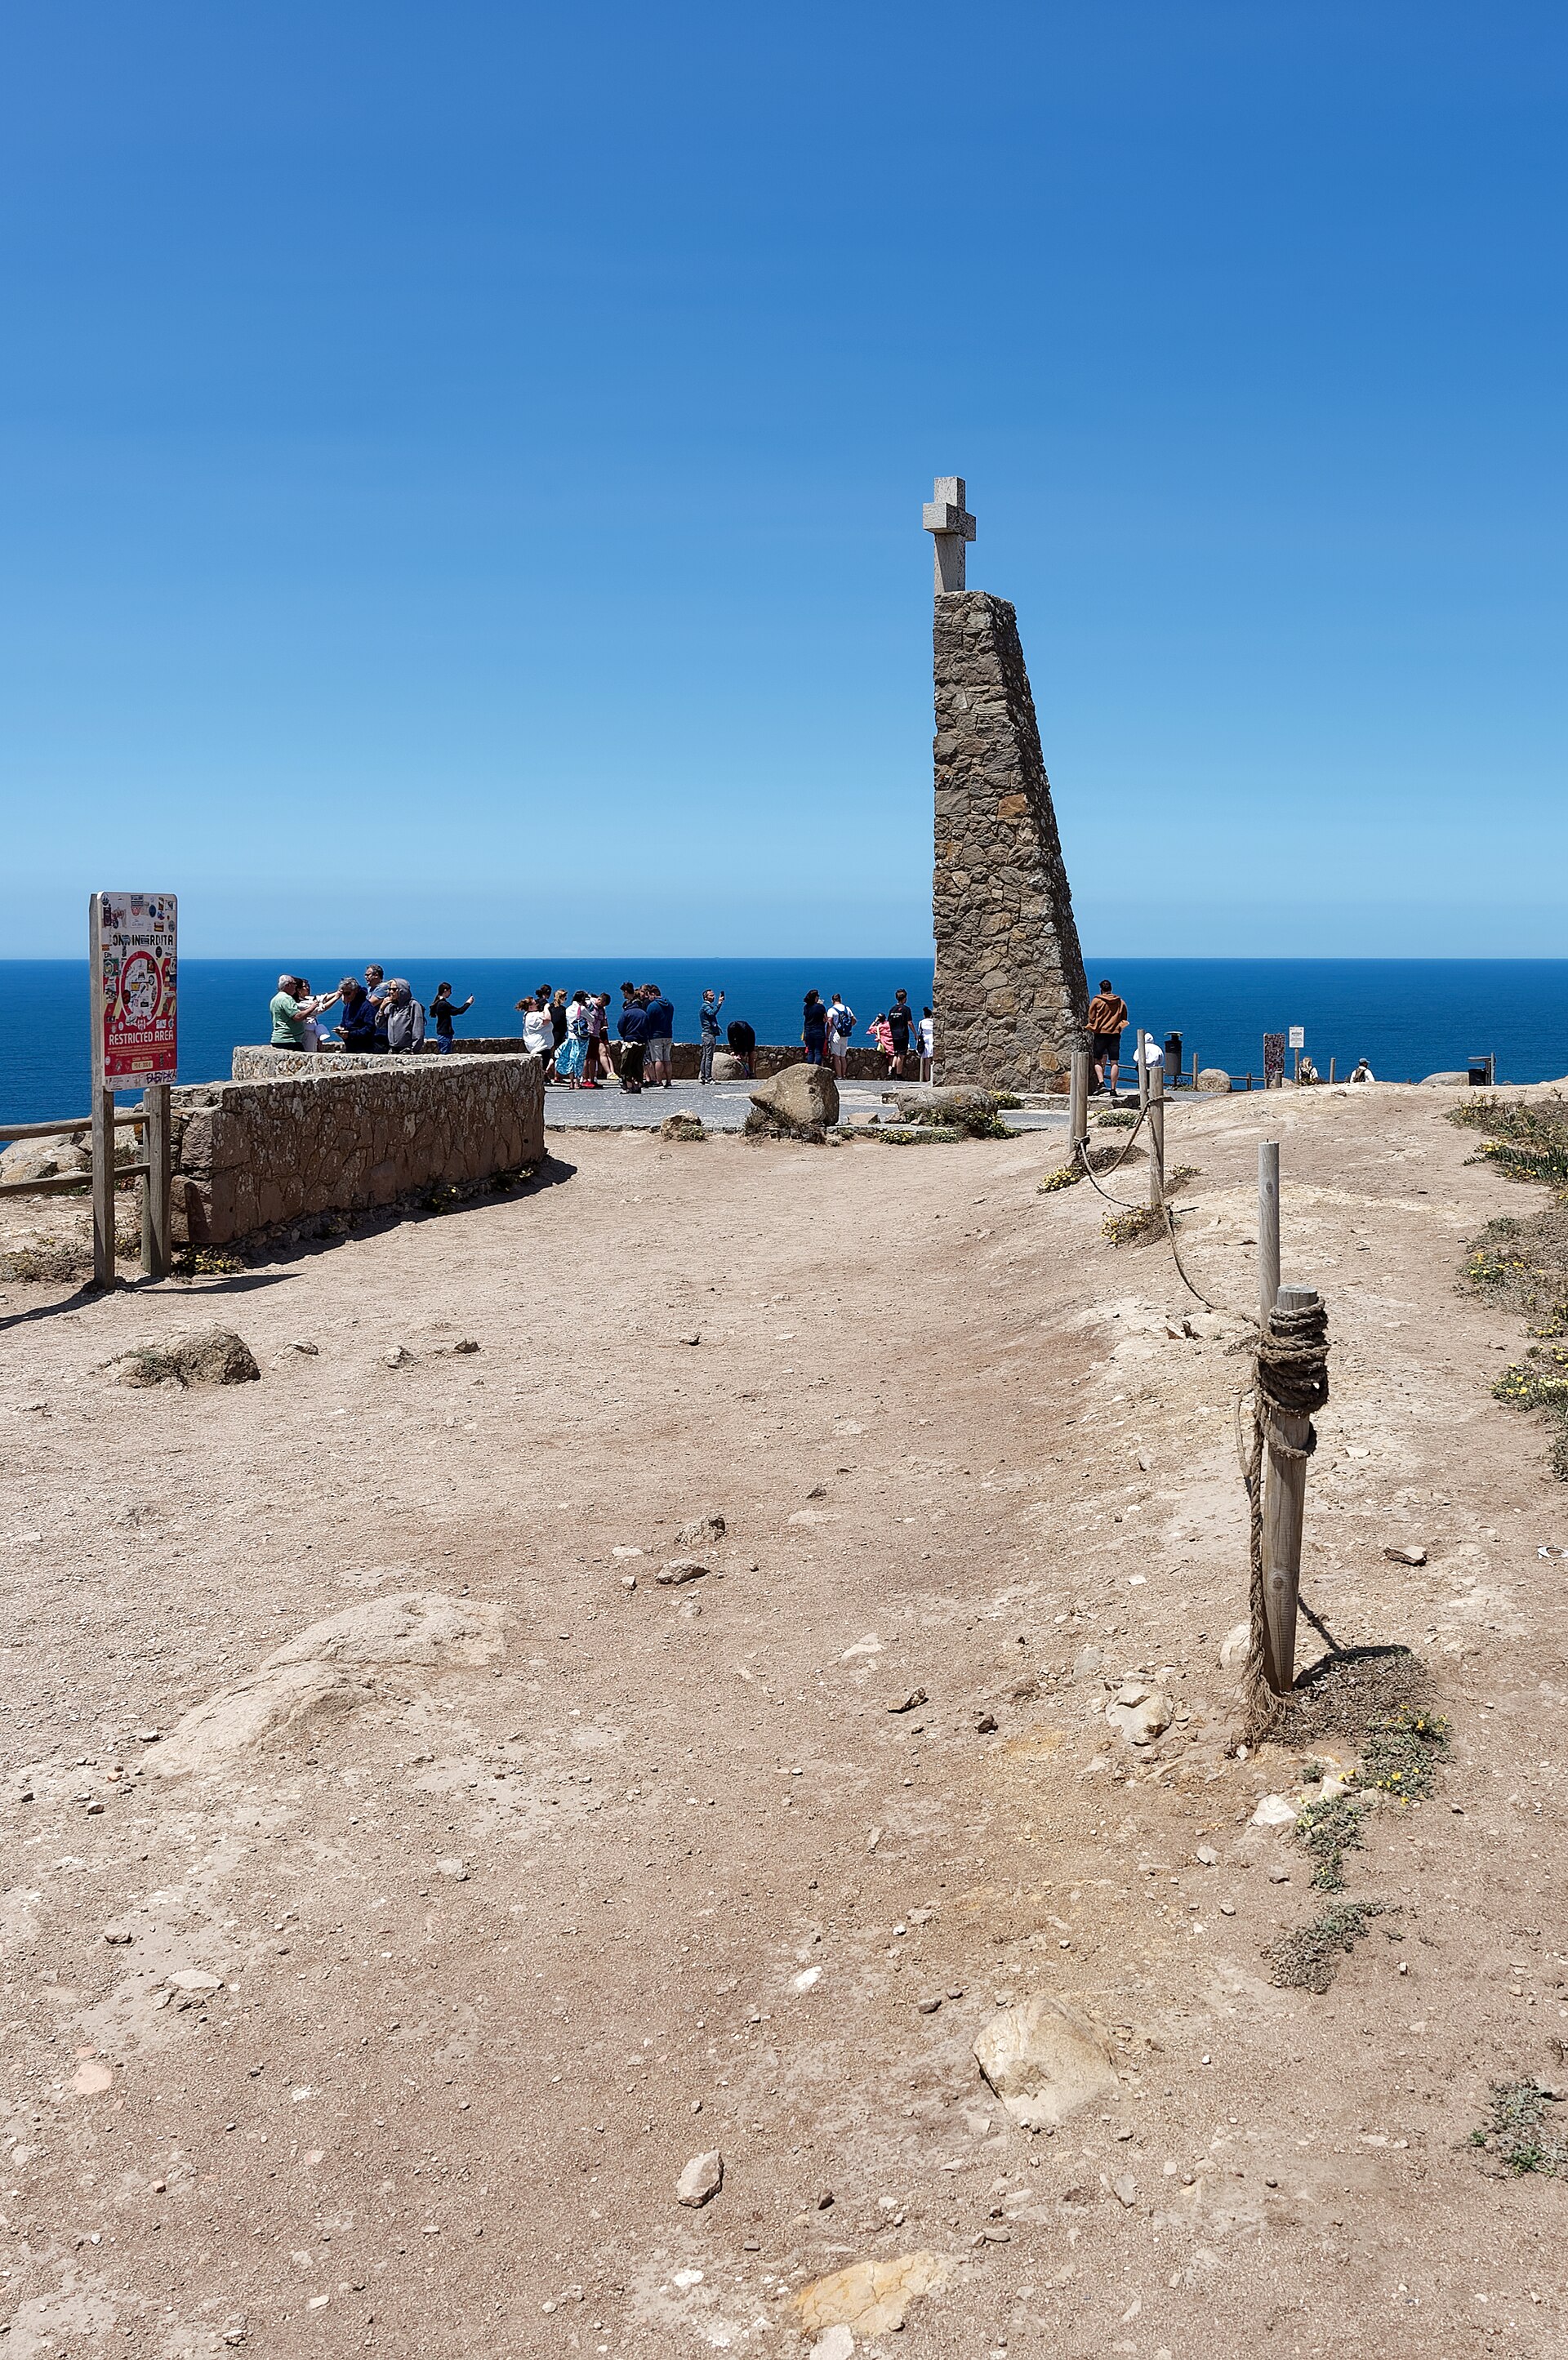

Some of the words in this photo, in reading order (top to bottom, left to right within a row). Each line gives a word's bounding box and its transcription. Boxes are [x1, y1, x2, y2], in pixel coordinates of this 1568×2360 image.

[109, 934, 131, 946] ON
[132, 934, 173, 946] INRDITA
[109, 1031, 154, 1045] RESTRICTED
[154, 1030, 174, 1041] AREA
